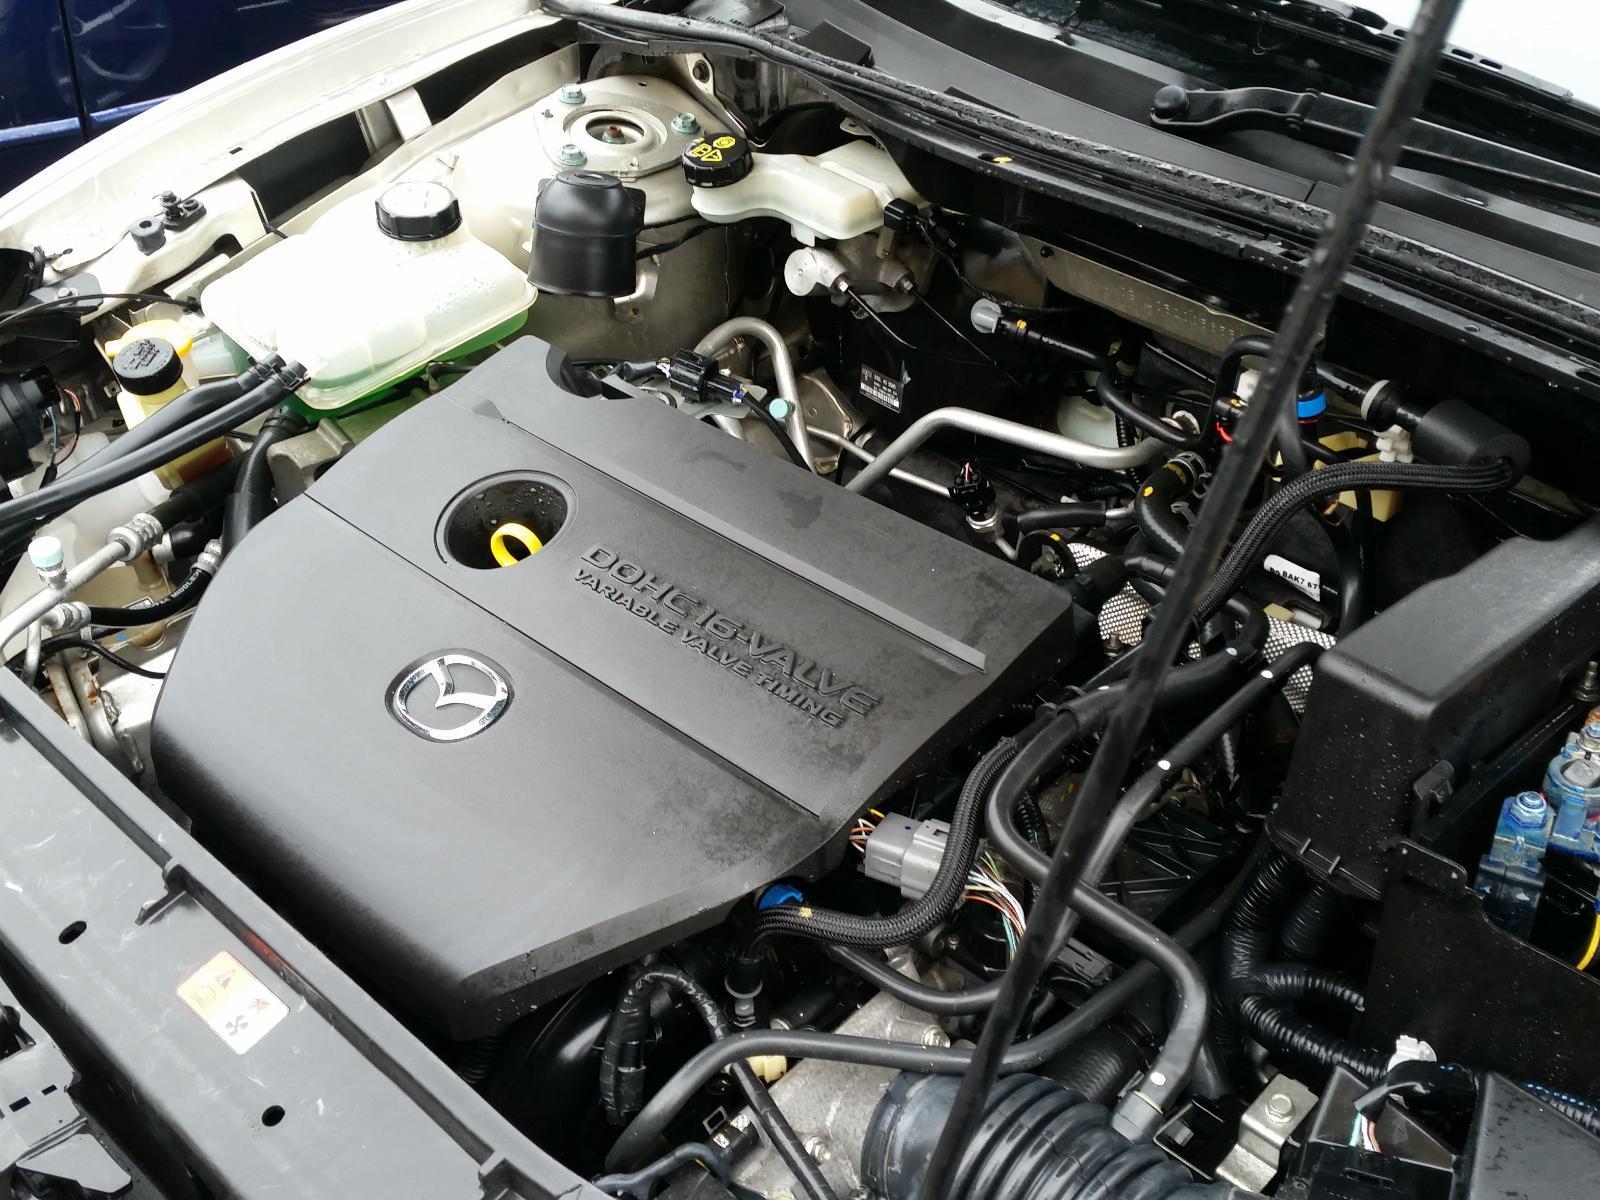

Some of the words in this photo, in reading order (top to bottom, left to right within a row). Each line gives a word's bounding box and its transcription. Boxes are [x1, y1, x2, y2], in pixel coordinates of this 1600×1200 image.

[575, 568, 679, 635] VARIABLE
[681, 629, 752, 679] VALVE
[755, 671, 845, 728] TIMING
[580, 546, 699, 616] DOHC
[695, 608, 882, 718] 16-VALVE
